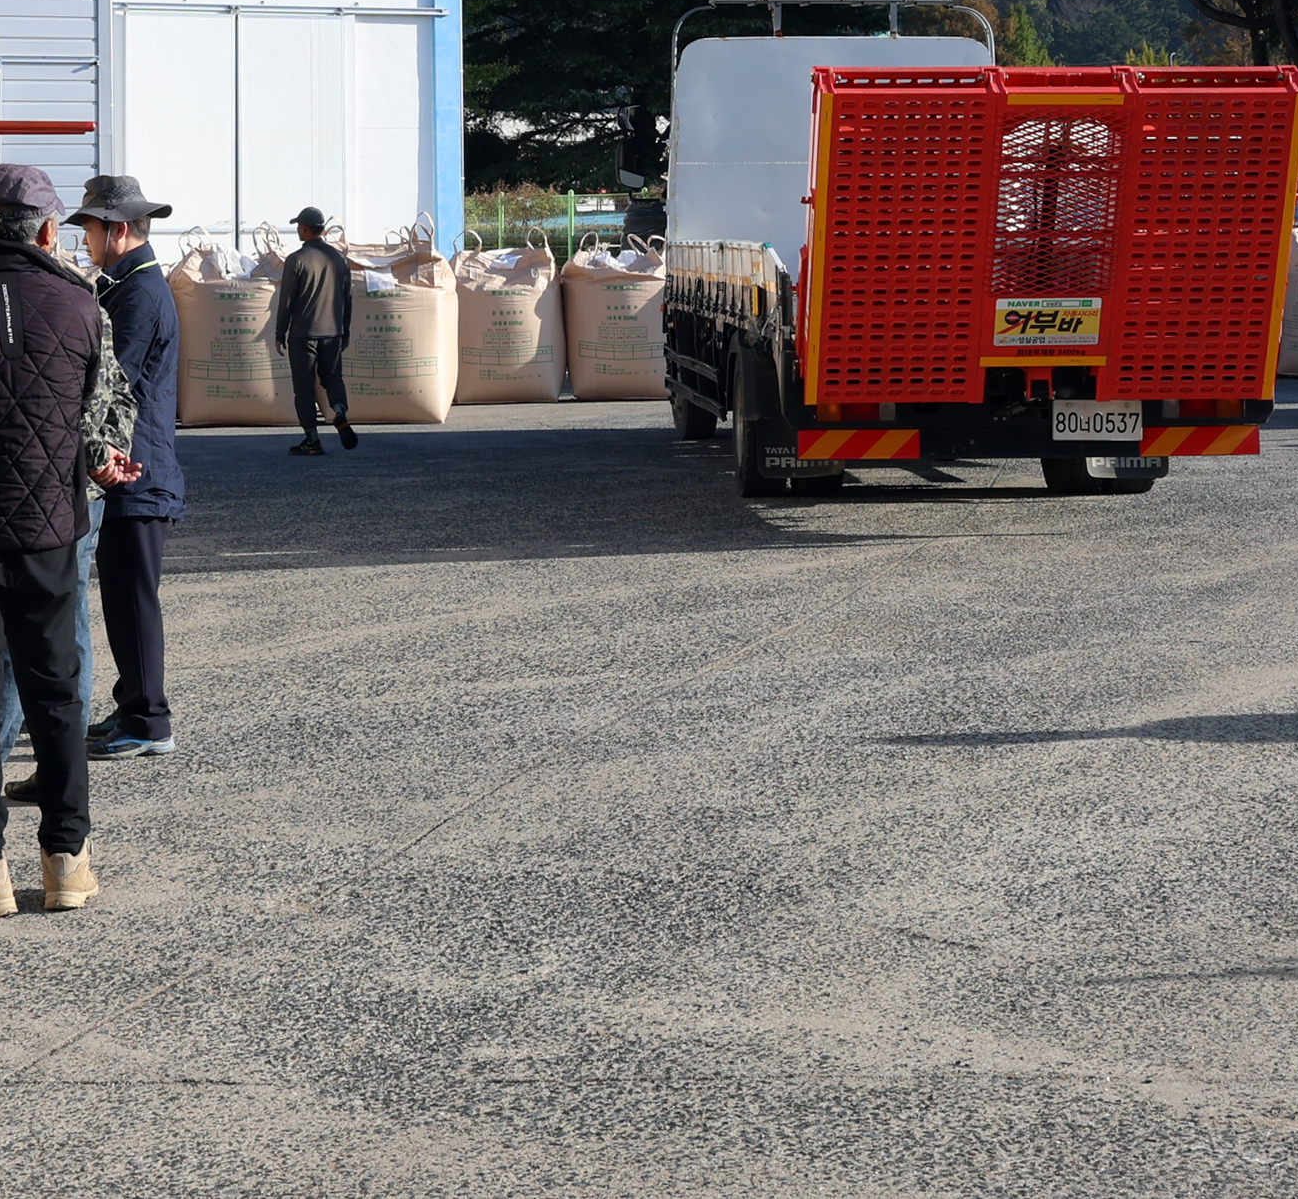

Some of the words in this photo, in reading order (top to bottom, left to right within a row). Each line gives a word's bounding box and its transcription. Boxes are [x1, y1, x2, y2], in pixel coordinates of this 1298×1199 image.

[1004, 310, 1084, 334] 어부바
[1055, 412, 1140, 433] 80너0537
[1091, 456, 1162, 468] PRIMA
